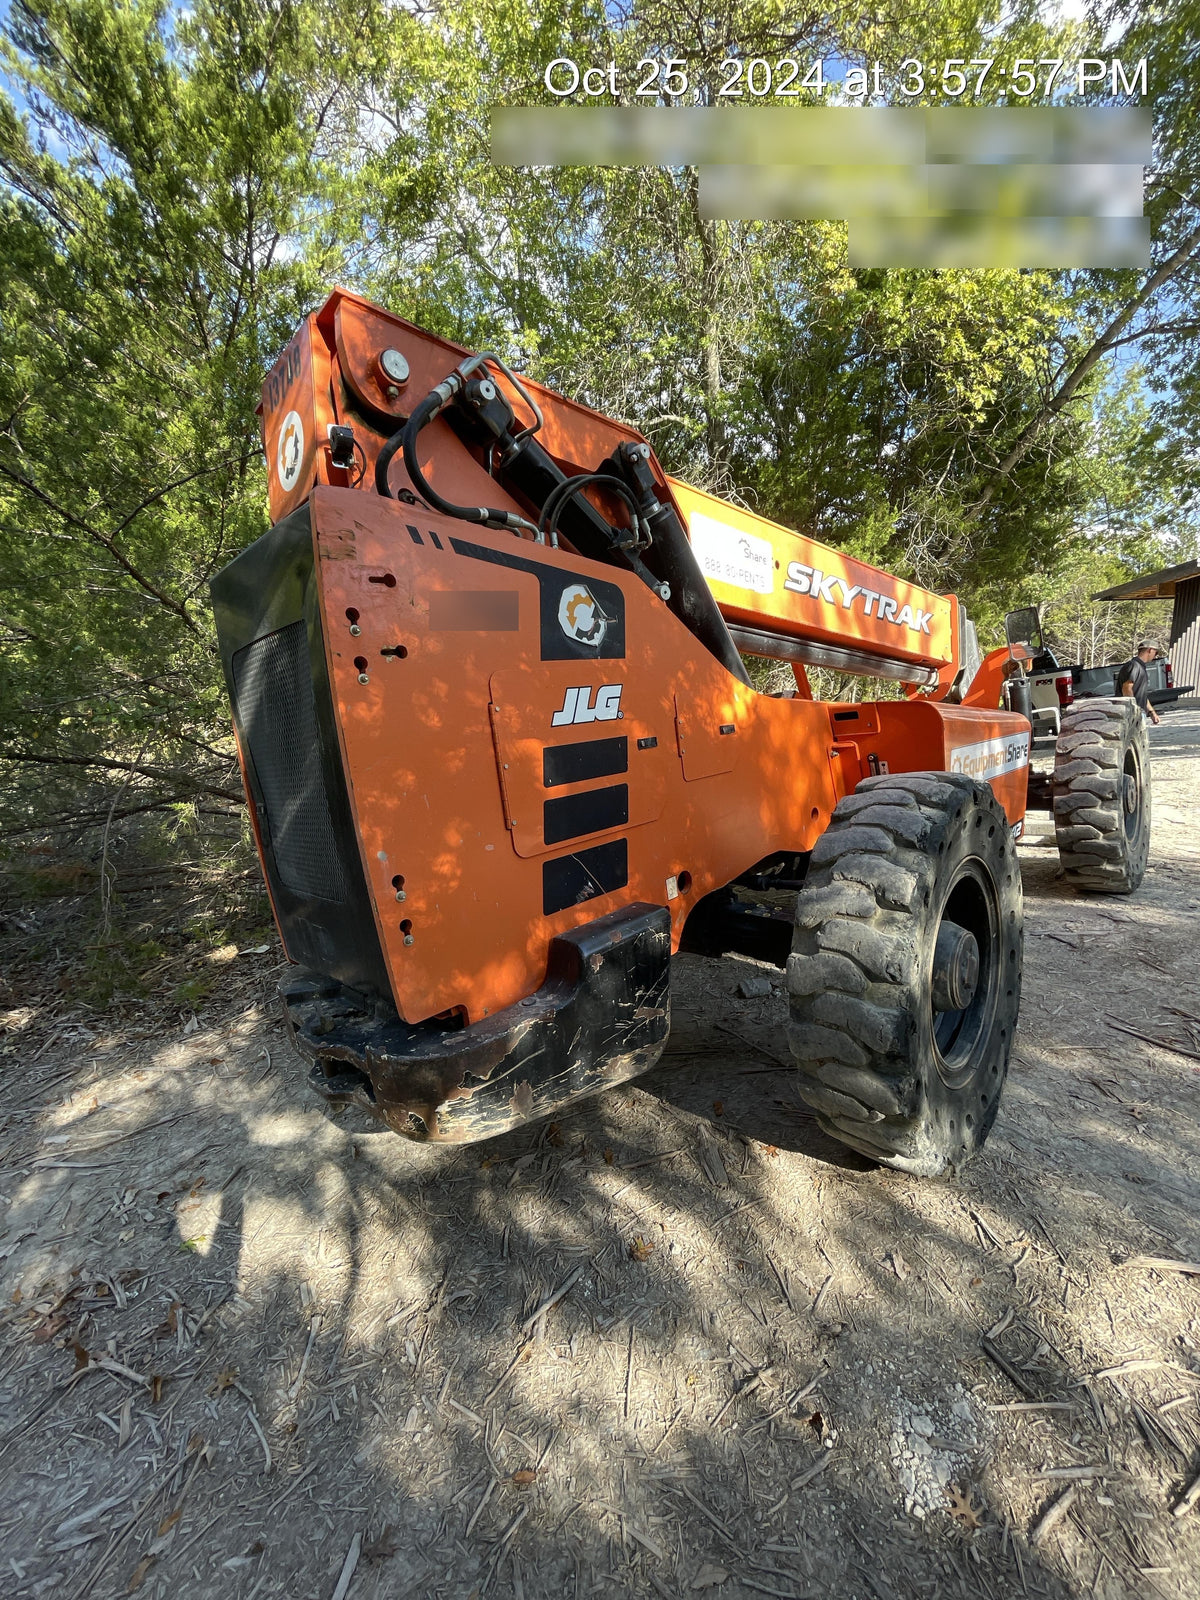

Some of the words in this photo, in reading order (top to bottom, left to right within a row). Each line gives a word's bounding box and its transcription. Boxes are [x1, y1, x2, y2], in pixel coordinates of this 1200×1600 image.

[784, 560, 934, 636] SKYTRAK
[551, 683, 624, 727] JLG
[963, 742, 1028, 778] EquipmentShare
